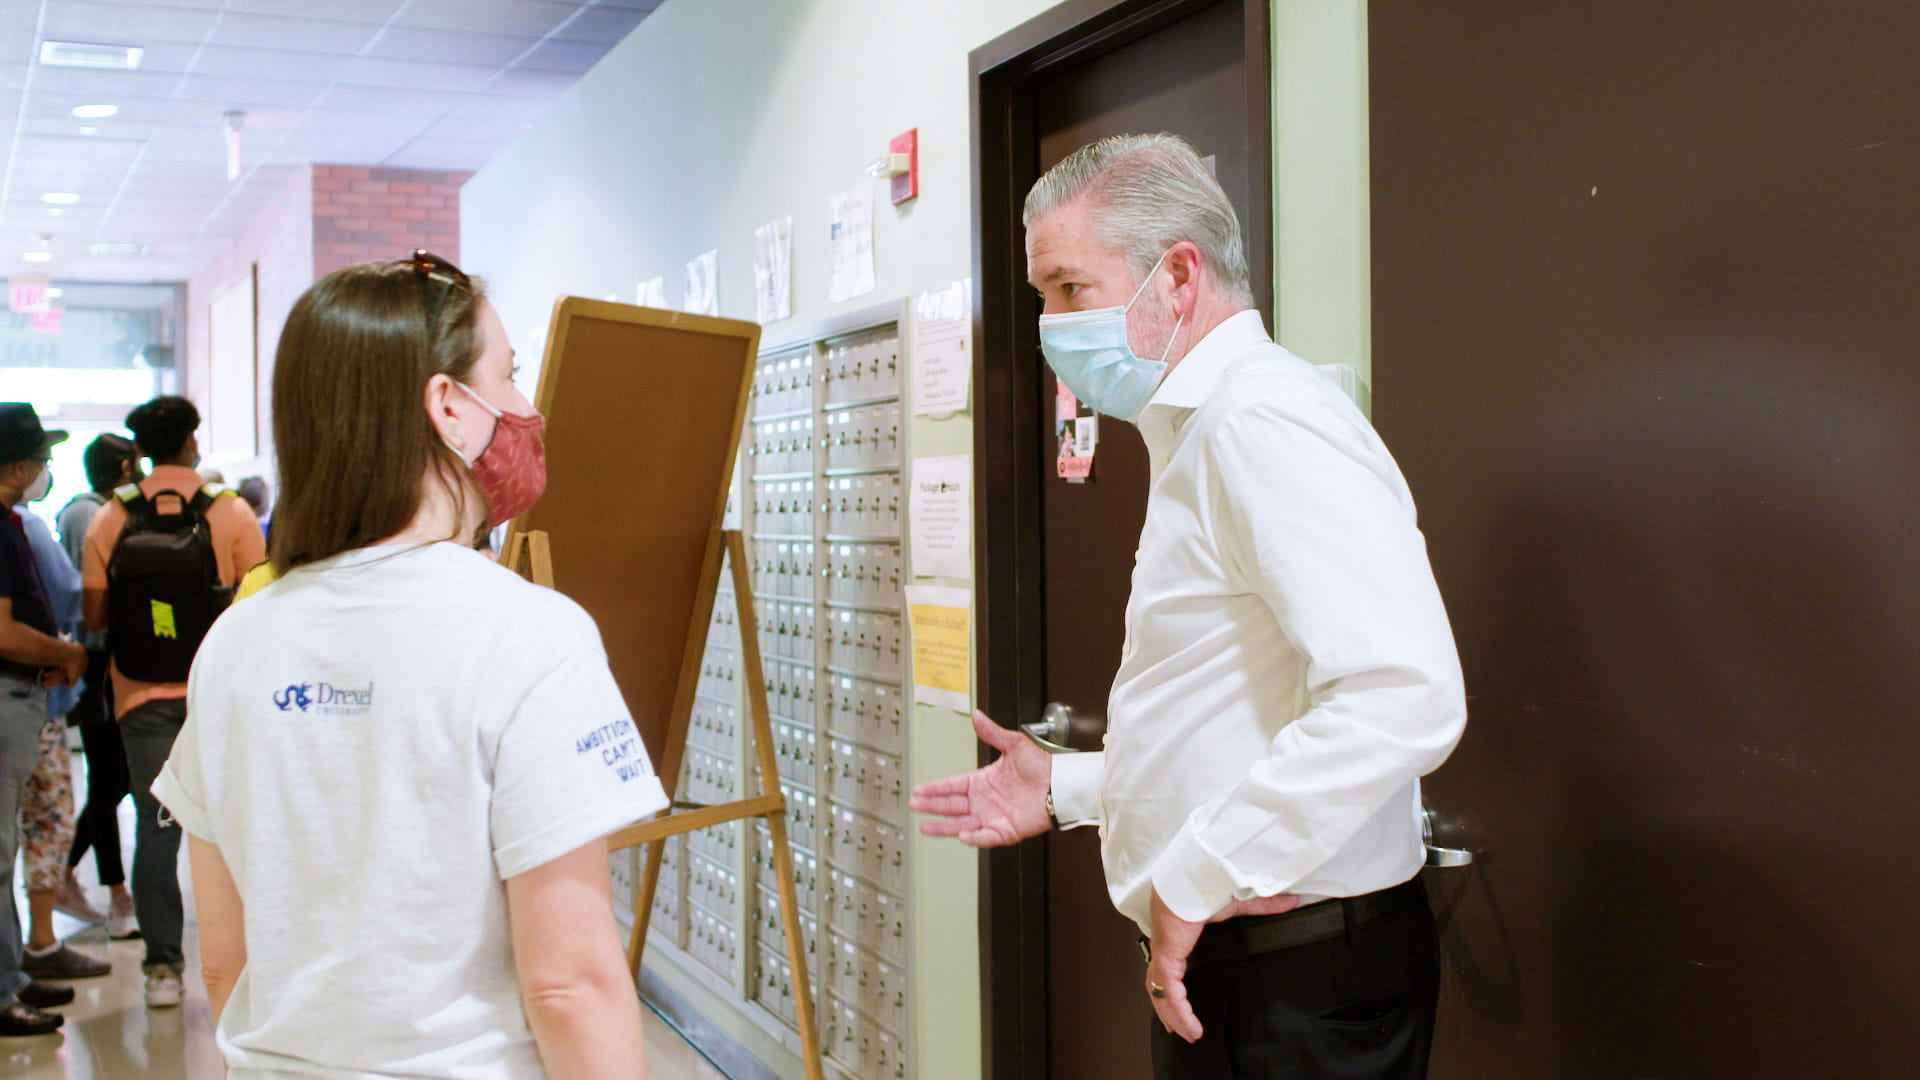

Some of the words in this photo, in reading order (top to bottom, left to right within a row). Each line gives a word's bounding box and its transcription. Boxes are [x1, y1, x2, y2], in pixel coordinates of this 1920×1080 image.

[318, 681, 373, 704] Drexel
[576, 719, 630, 756] AMBITION
[602, 738, 637, 766] CAN'T
[616, 758, 646, 782] WAIT
